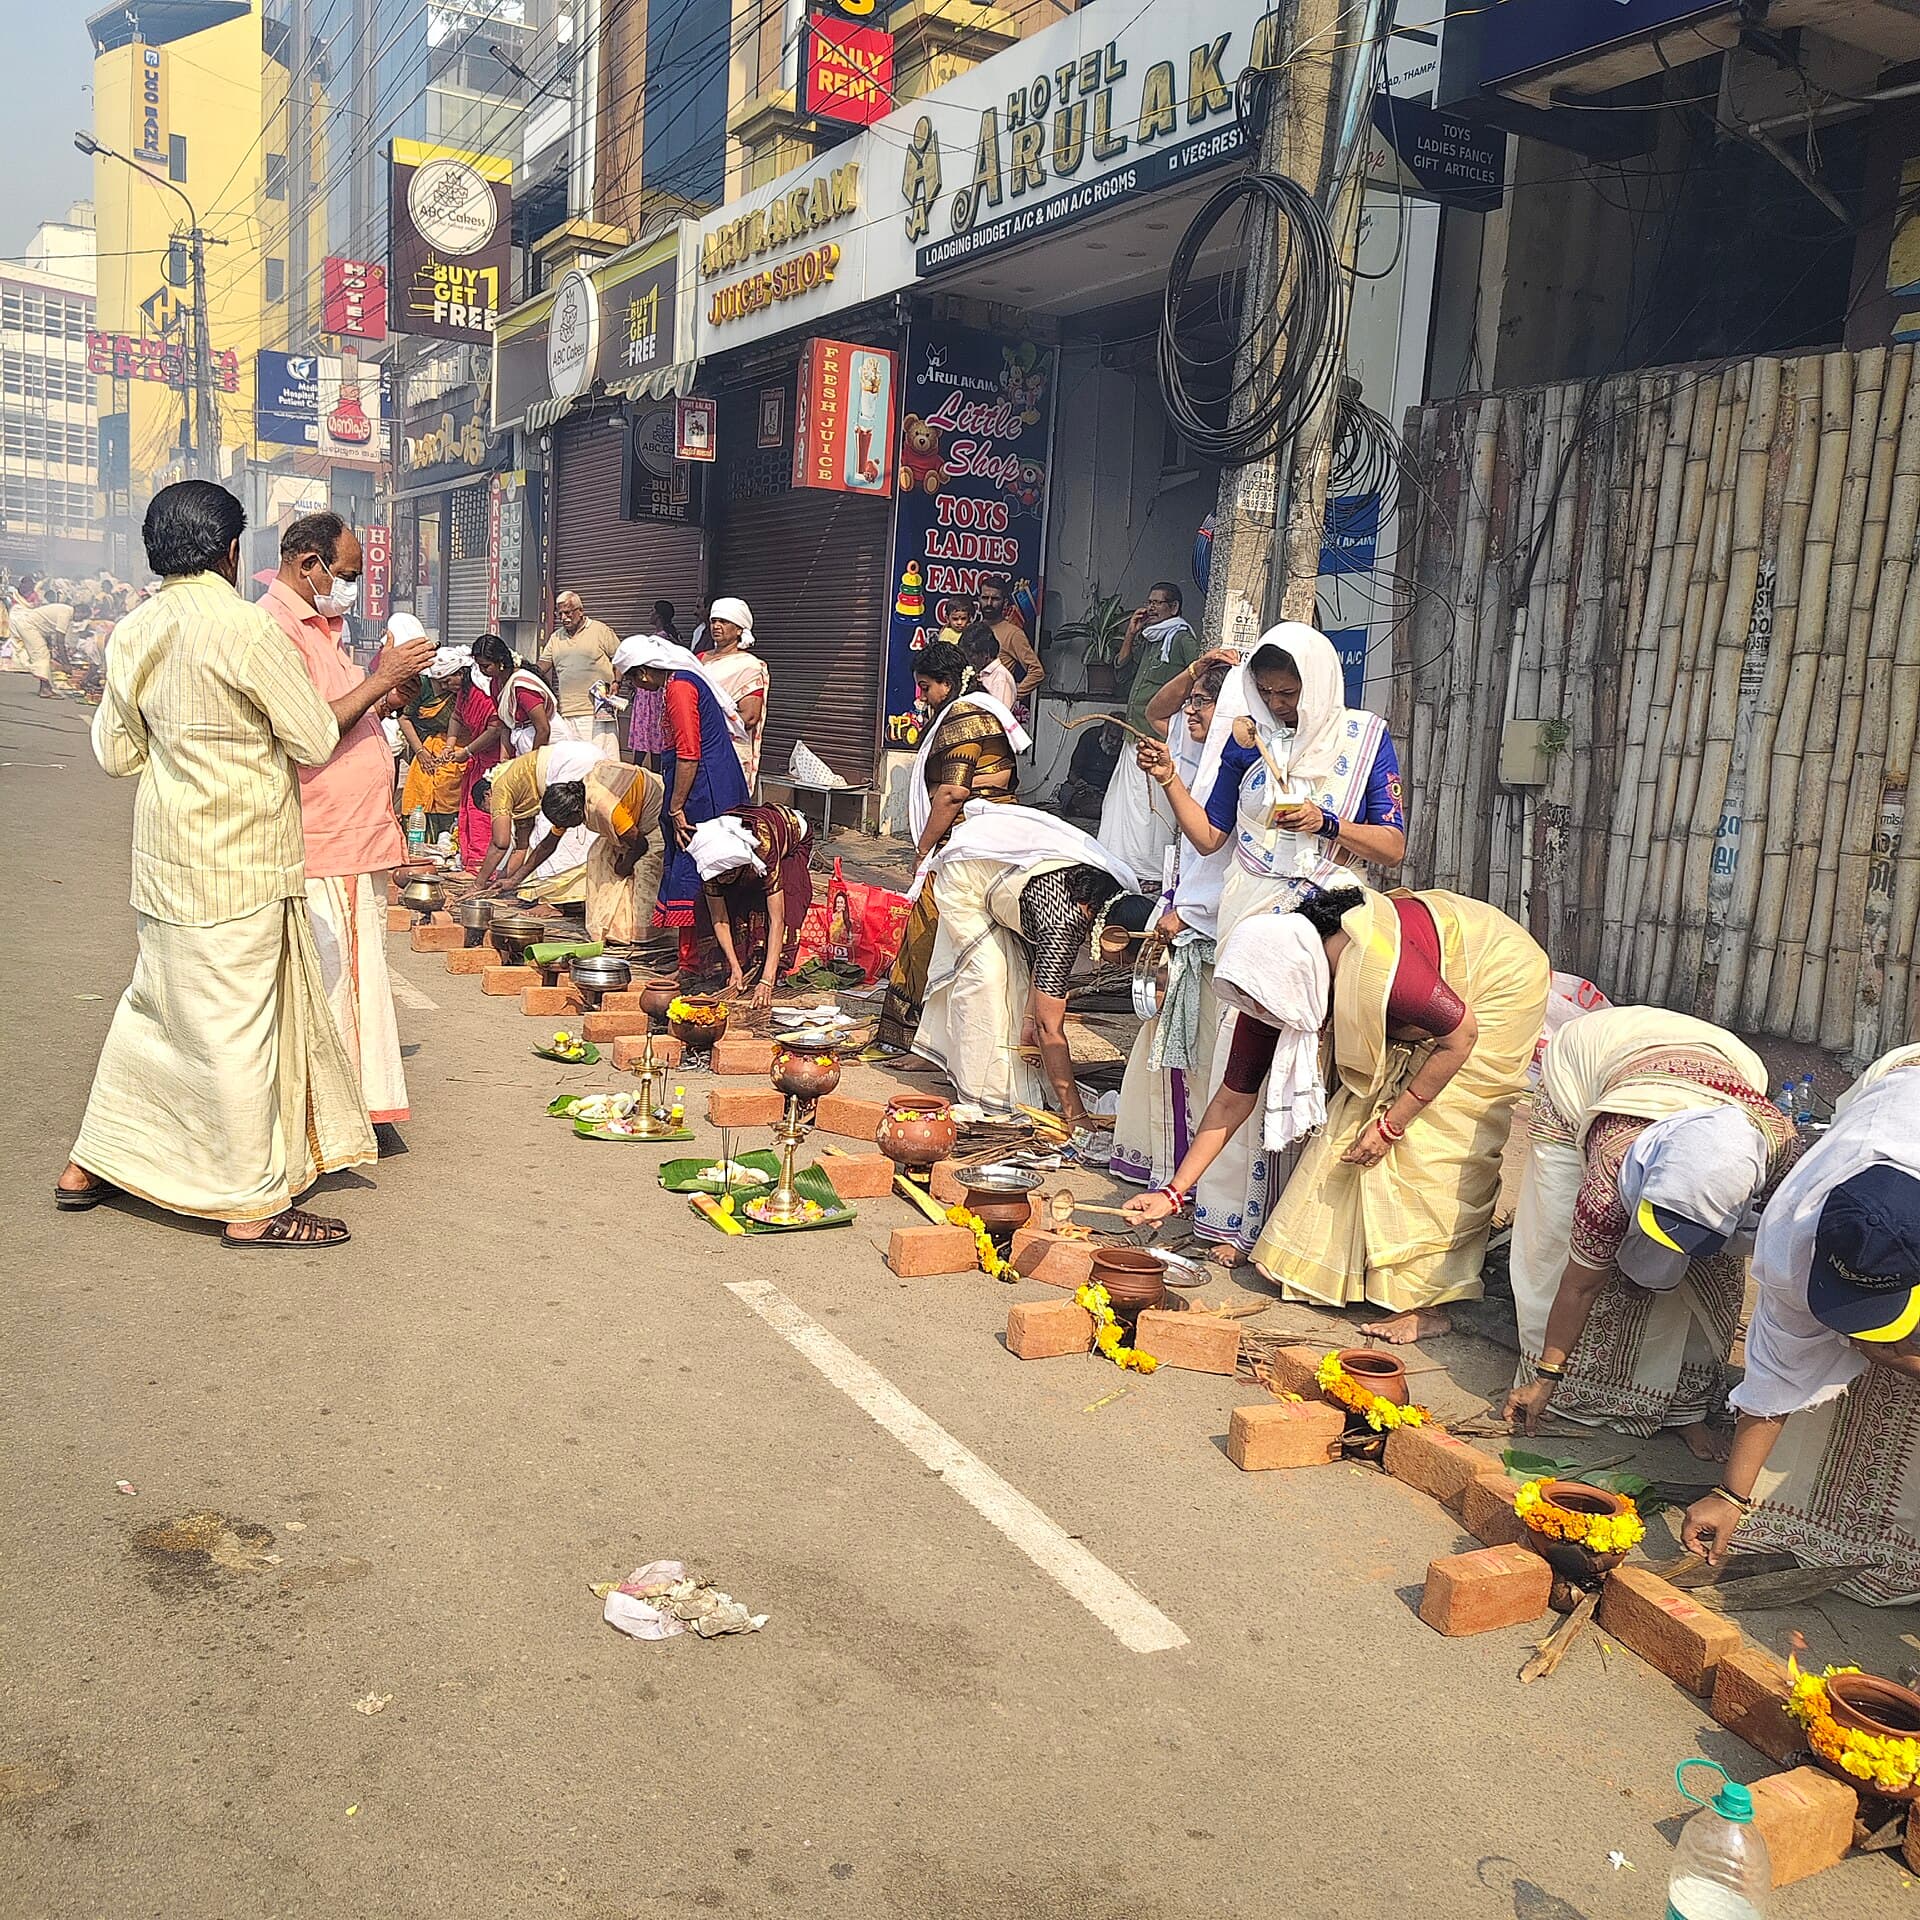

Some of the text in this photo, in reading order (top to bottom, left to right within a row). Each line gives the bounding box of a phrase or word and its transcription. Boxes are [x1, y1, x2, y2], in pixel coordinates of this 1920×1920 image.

[817, 39, 884, 76] DAILY
[144, 69, 159, 105] UCO
[818, 68, 879, 104] RENT
[1007, 40, 1128, 131] HOTEL
[144, 106, 159, 152] BANK
[1442, 123, 1471, 142] TOYS
[1417, 135, 1494, 165] LADIES FANCY
[1413, 154, 1496, 185] GIFT ARTICLES
[420, 204, 446, 220] ABC
[699, 162, 860, 279] ARULAKAM
[925, 168, 1137, 267] LOADGING BUDGET A/C & NON A/C ROOMS
[433, 262, 499, 311] BUY 1
[433, 282, 478, 306] GET
[707, 243, 841, 327] JUICE SHOP
[433, 300, 498, 332] FREE
[630, 294, 650, 321] BUY
[630, 315, 648, 342] GET
[628, 333, 657, 368] FREE
[916, 366, 999, 394] ARULAKAM
[817, 346, 840, 481] FRESH JUICE
[925, 389, 1023, 441] Little
[641, 442, 661, 453] ABC
[943, 438, 1021, 490] Shop
[651, 503, 685, 517] FREE
[935, 494, 1009, 533] TOYS
[924, 528, 1019, 567] LADIES
[369, 528, 386, 617] HOTEL
[1345, 650, 1363, 665] A/C
